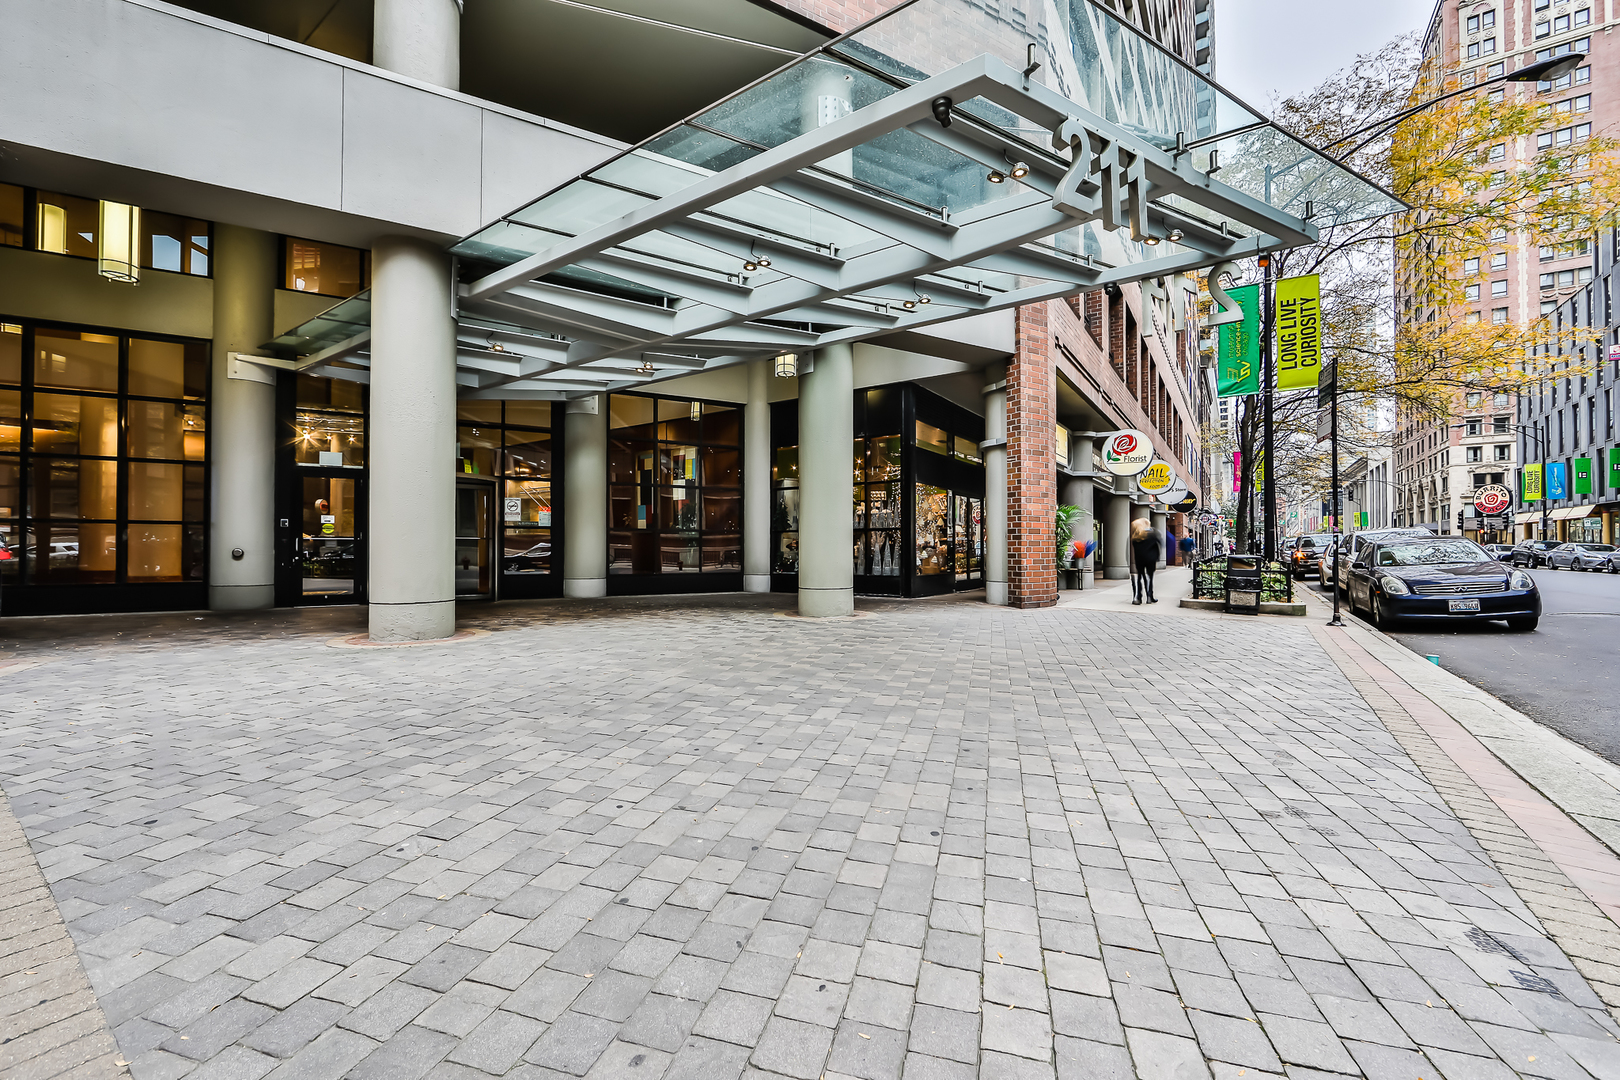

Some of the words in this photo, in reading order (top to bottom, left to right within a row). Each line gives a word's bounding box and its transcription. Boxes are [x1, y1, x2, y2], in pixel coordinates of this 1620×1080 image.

[1052, 115, 1149, 243] 211
[1280, 298, 1298, 330] LIVE
[1299, 297, 1318, 368] CURIOSITY
[1280, 333, 1298, 371] LONG
[1123, 455, 1147, 463] Florist
[1139, 468, 1165, 479] NAIL
[1478, 501, 1507, 513] BEACH
